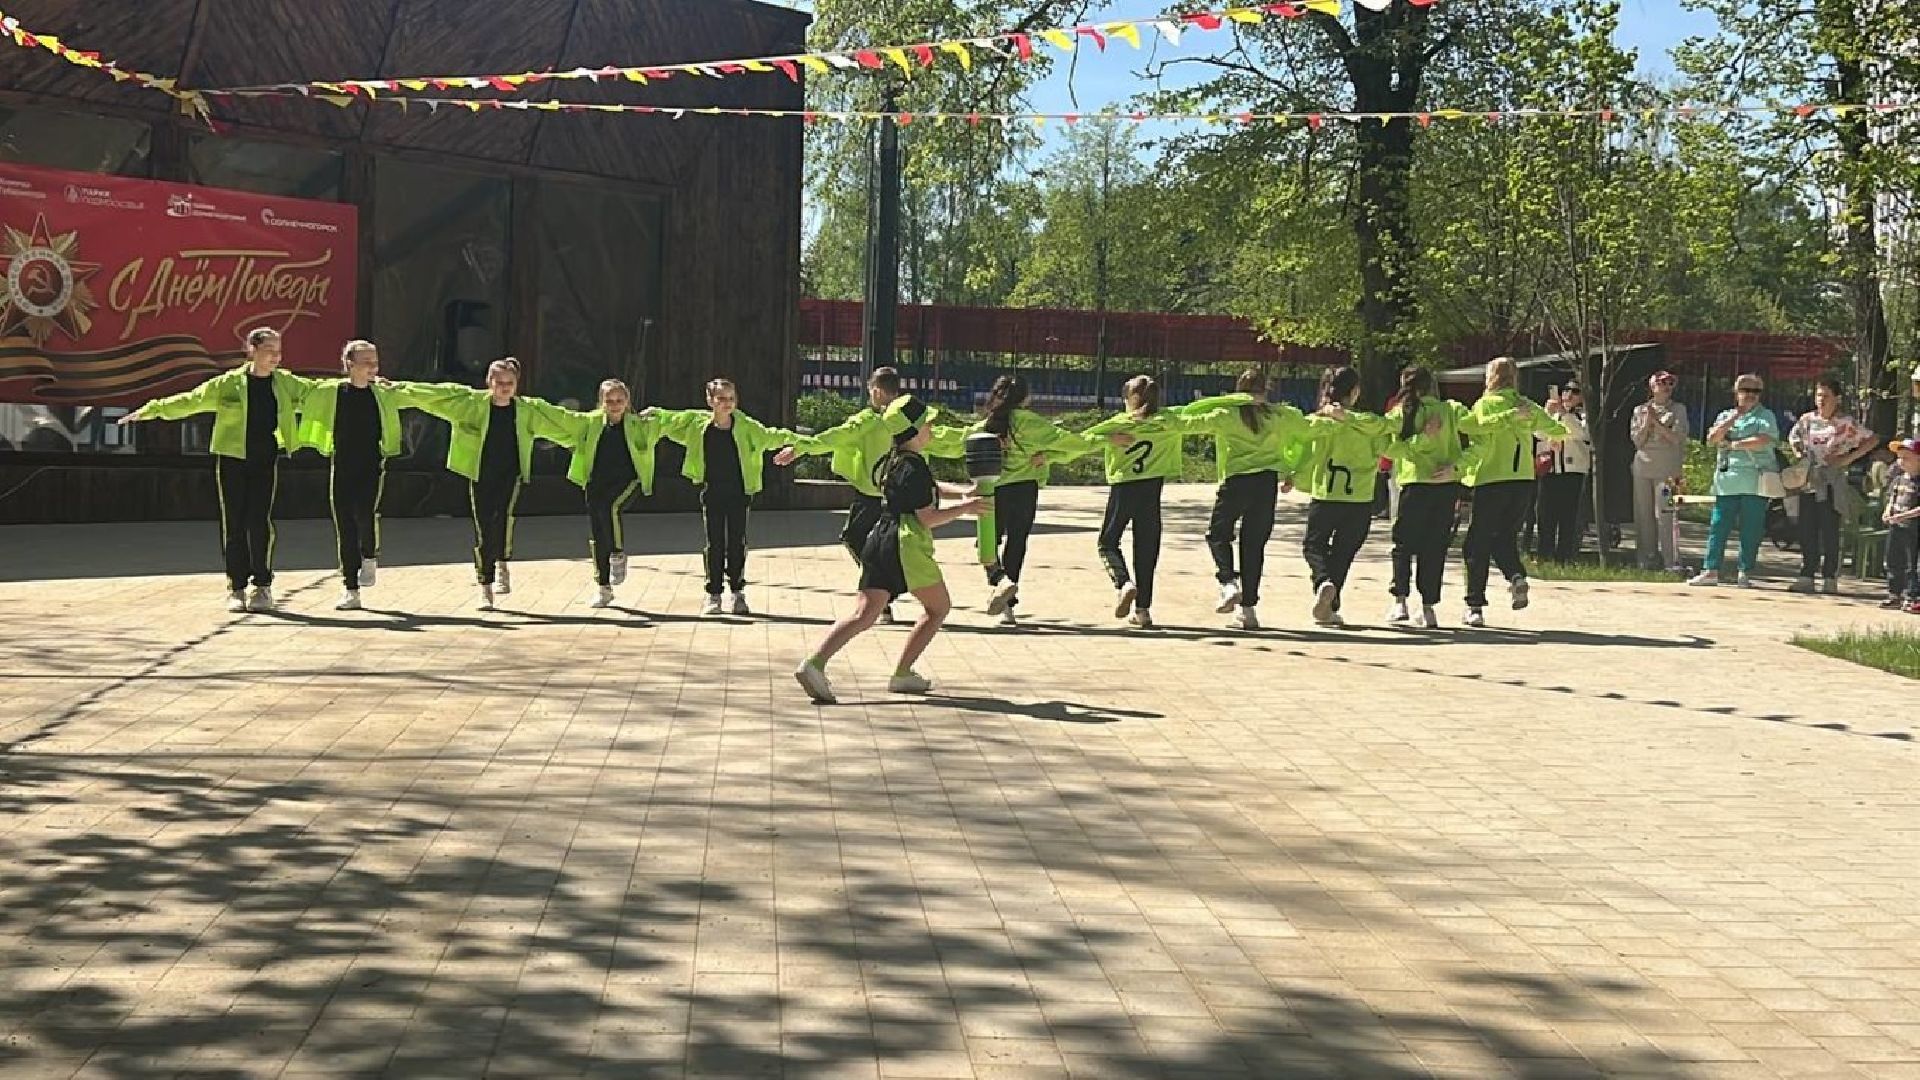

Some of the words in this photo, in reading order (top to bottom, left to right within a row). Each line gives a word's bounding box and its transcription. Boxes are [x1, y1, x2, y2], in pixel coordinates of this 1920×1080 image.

[108, 257, 144, 311] С
[120, 257, 225, 340] Днём
[180, 248, 332, 341] Победы
